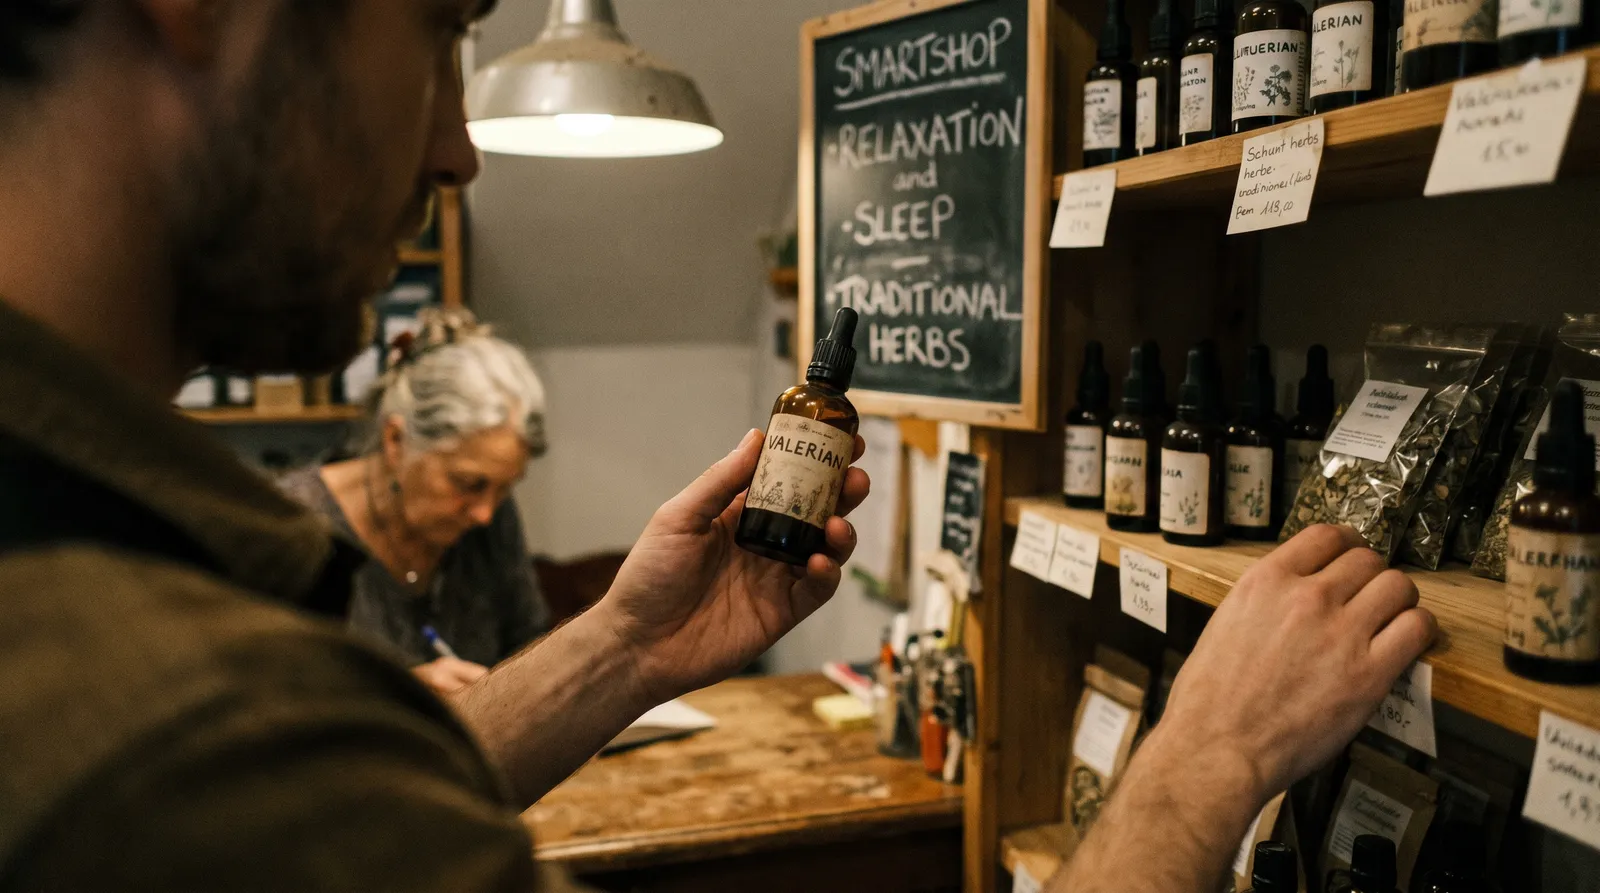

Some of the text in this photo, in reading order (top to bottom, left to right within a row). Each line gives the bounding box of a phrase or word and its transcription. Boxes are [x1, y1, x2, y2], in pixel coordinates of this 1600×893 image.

[833, 17, 1012, 97] SMARTSHOP
[1290, 131, 1319, 149] herbs
[892, 160, 938, 191] and
[853, 194, 955, 246] SLEEP
[869, 323, 971, 371] HERBS
